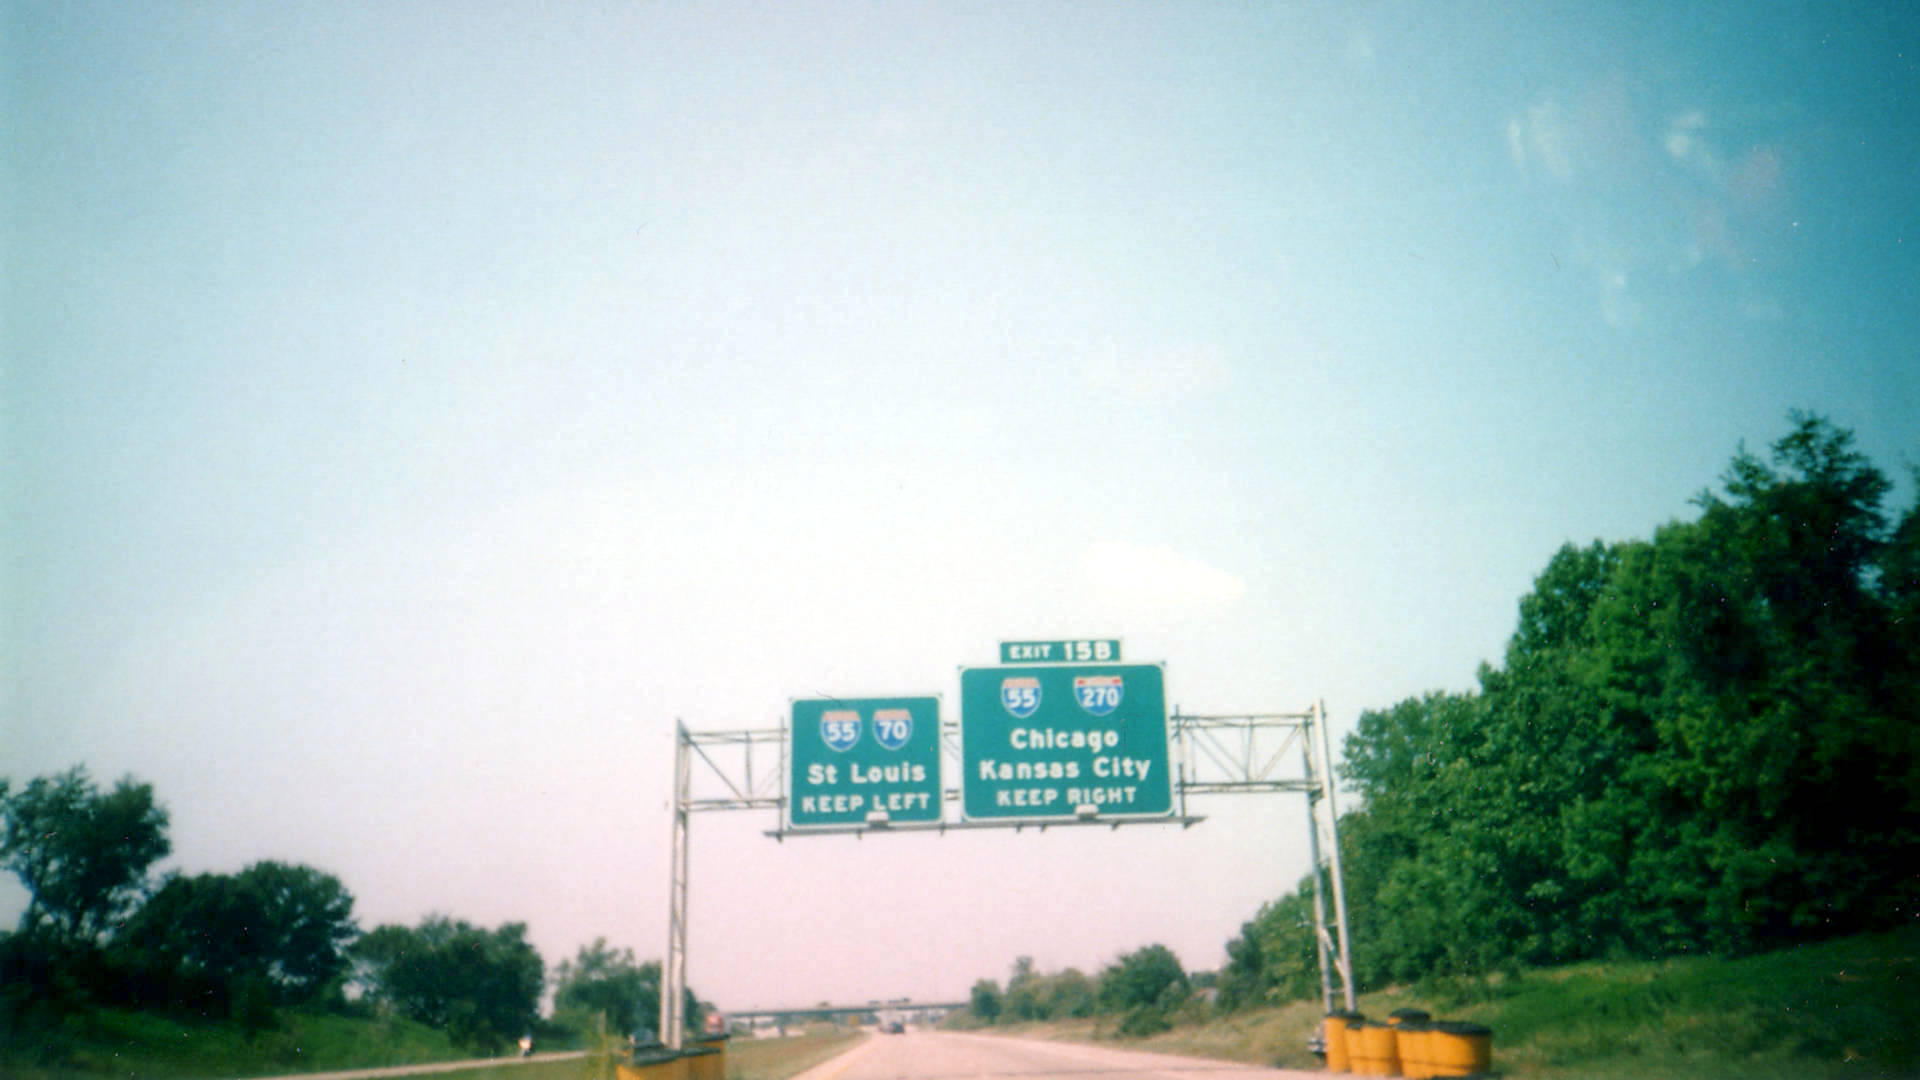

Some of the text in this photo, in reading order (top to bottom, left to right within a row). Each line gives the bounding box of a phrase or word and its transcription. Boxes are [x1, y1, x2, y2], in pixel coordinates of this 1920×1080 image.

[1009, 641, 1111, 660] EXIT 15B
[1007, 689, 1035, 708] 55
[1083, 688, 1118, 706] 270
[827, 722, 856, 742] 55
[879, 721, 907, 740] 70
[1010, 728, 1118, 753] Chicago
[807, 761, 926, 784] St Louis
[979, 756, 1151, 781] Kansas City
[802, 792, 930, 813] KEEP LEFT
[997, 787, 1137, 806] KEEP RIGHT
